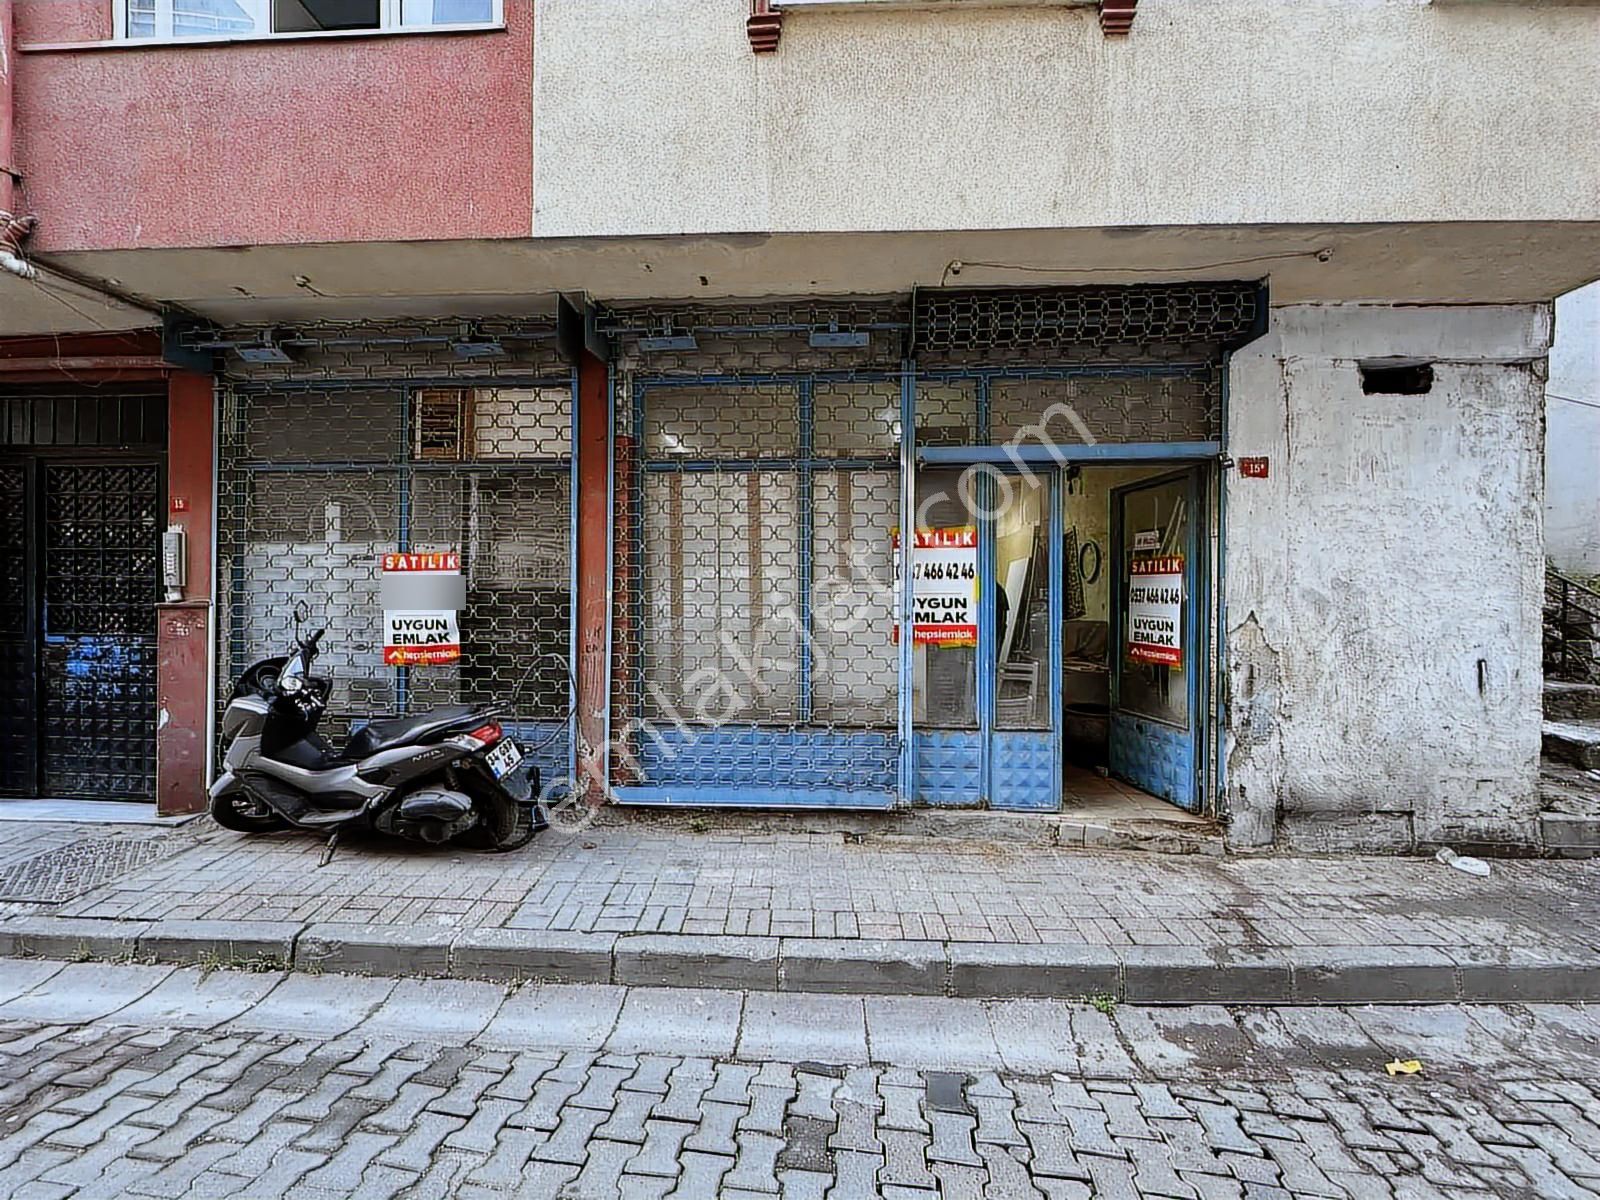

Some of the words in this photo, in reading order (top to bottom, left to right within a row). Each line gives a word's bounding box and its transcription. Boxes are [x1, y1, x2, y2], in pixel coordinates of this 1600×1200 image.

[385, 556, 456, 569] SATILIK
[1131, 558, 1180, 573] SATILIK
[923, 563, 943, 580] 466
[946, 563, 959, 580] 42
[961, 563, 975, 580] 46
[914, 612, 968, 623] MLAK
[392, 619, 448, 631] UYGUN
[1133, 618, 1174, 632] UYGUN
[392, 632, 450, 645] EMLAK
[914, 629, 974, 641] hepsiemlak
[1133, 631, 1174, 646] EMLAK
